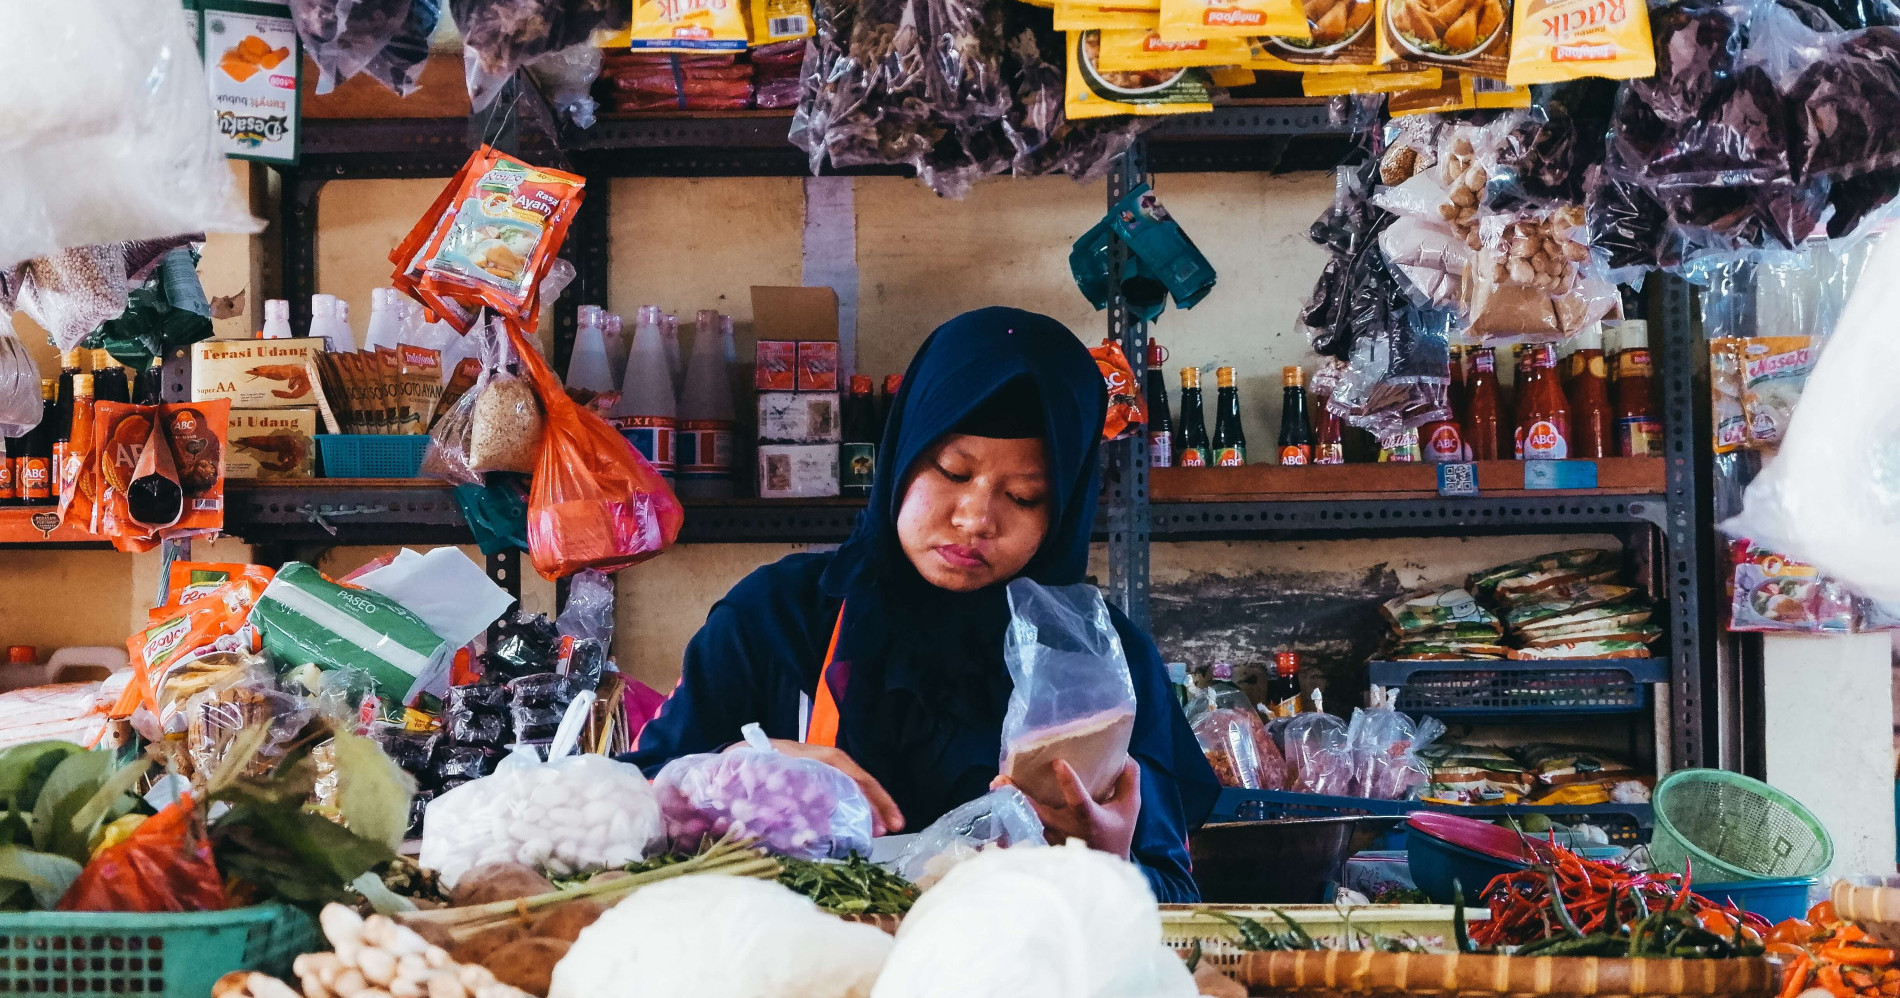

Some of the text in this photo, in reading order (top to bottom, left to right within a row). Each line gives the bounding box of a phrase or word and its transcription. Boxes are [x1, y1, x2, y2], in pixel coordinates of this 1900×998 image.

[219, 116, 284, 142] Desaku
[535, 190, 560, 207] Rasa
[515, 195, 552, 217] Ayam
[201, 346, 308, 360] Terasi Udang
[216, 381, 237, 393] AA
[400, 381, 421, 397] SOTO
[174, 420, 195, 430] ABC
[247, 416, 299, 429] Udang
[1436, 438, 1458, 449] ABC
[1531, 434, 1556, 445] ABC
[1281, 455, 1303, 466] ABC
[24, 468, 46, 479] ABC
[336, 590, 377, 615] PASEO
